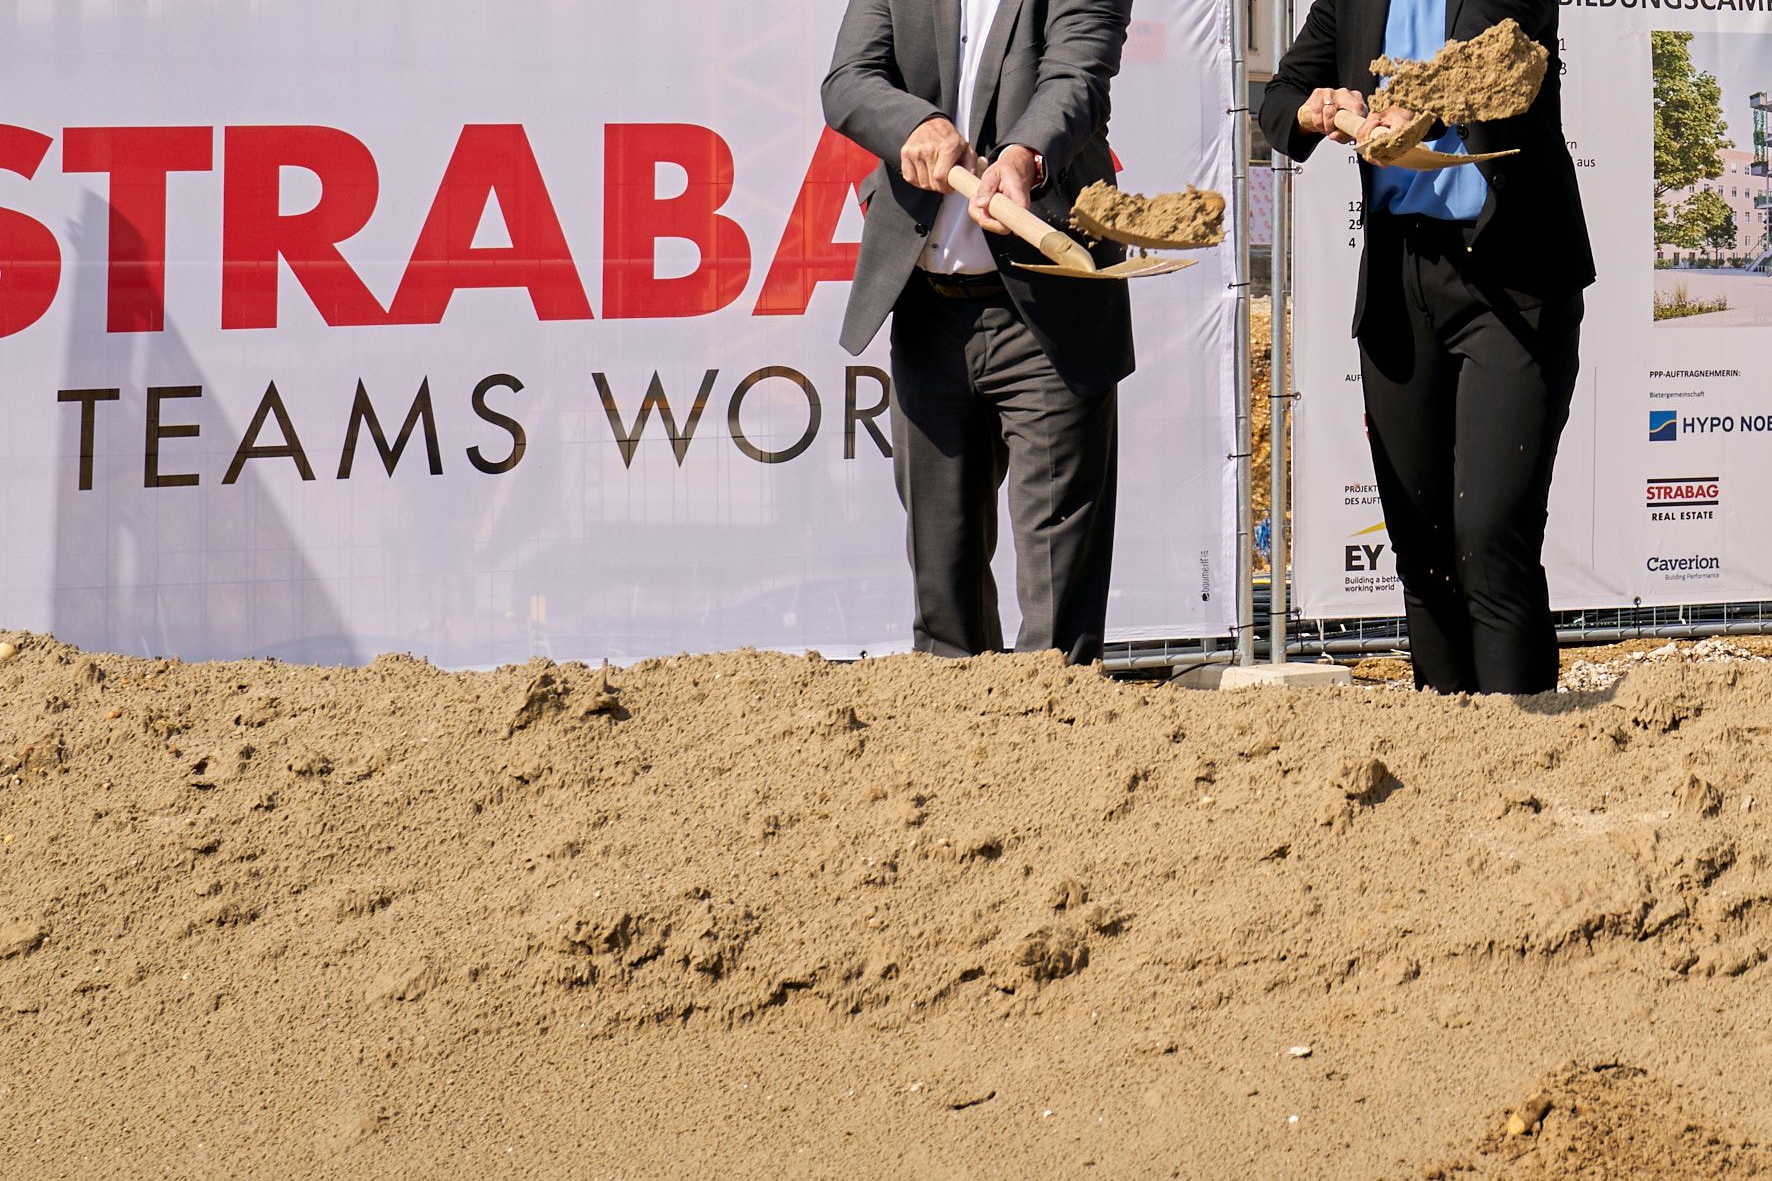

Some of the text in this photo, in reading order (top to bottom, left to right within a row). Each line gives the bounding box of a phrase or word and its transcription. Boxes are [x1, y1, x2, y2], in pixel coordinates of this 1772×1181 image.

[1577, 158, 1596, 168] aus
[1348, 237, 1356, 248] 4
[1649, 370, 1741, 378] PPP-AUFTRAGNEHMERIN:
[1649, 391, 1705, 399] Bietergemeinschaft
[1683, 416, 1734, 433] HYPO
[56, 372, 526, 491] TEAMS
[1646, 484, 1719, 500] STRABAG
[1651, 511, 1713, 521] REAL ESTATE
[1345, 544, 1385, 571] EY
[1647, 554, 1719, 571] Caverion
[1344, 577, 1374, 586] Building
[1344, 585, 1374, 593] working
